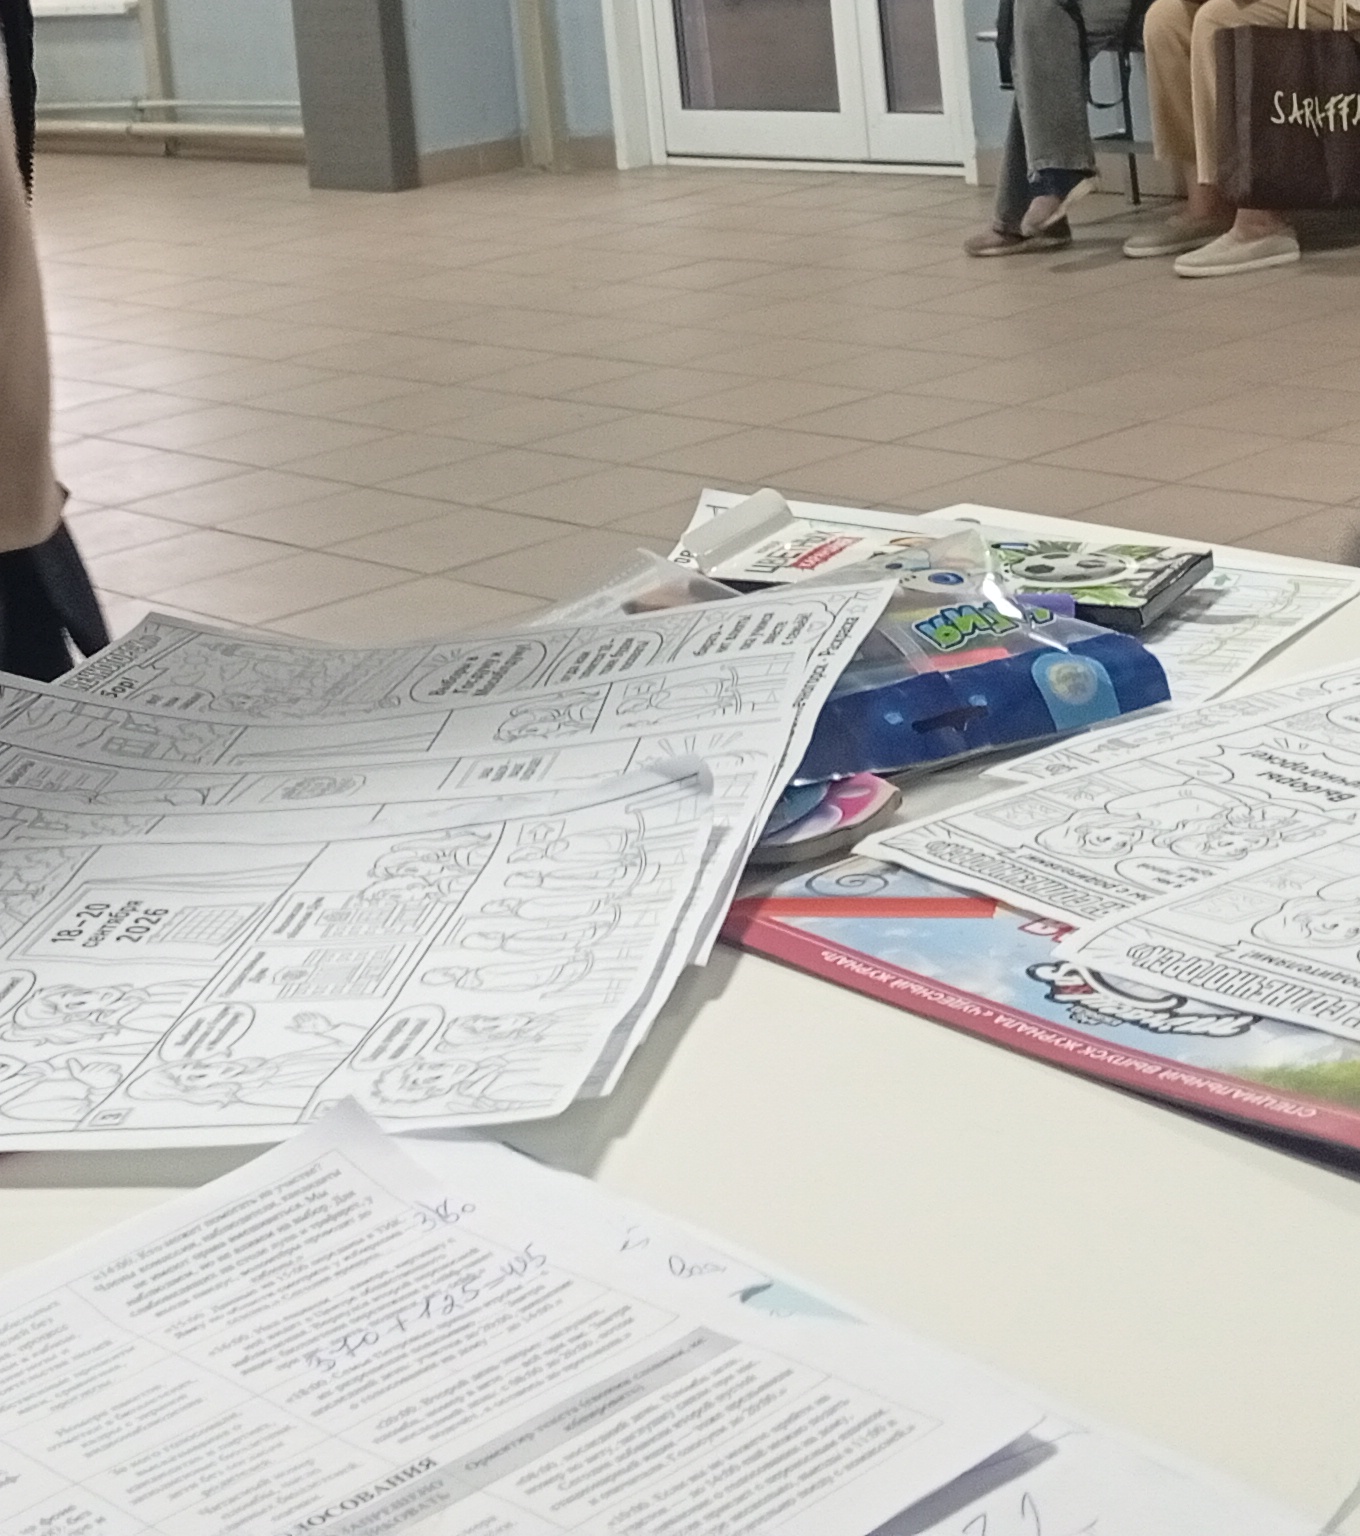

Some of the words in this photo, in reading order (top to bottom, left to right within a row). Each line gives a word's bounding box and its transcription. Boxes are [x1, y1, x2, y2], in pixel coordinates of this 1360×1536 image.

[1257, 770, 1357, 804] Выборы
[82, 899, 144, 949] сентября
[116, 908, 169, 943] 2026
[817, 948, 893, 984] ЖУРНАЛ»
[889, 974, 993, 1022] «ЧУДЕСНЫЙ
[993, 1012, 1086, 1054] ЖУРНАЛА
[1082, 1041, 1161, 1077] ВЫПУСК
[1159, 1060, 1318, 1124] СПЕЦИАЛЬНЫЙ
